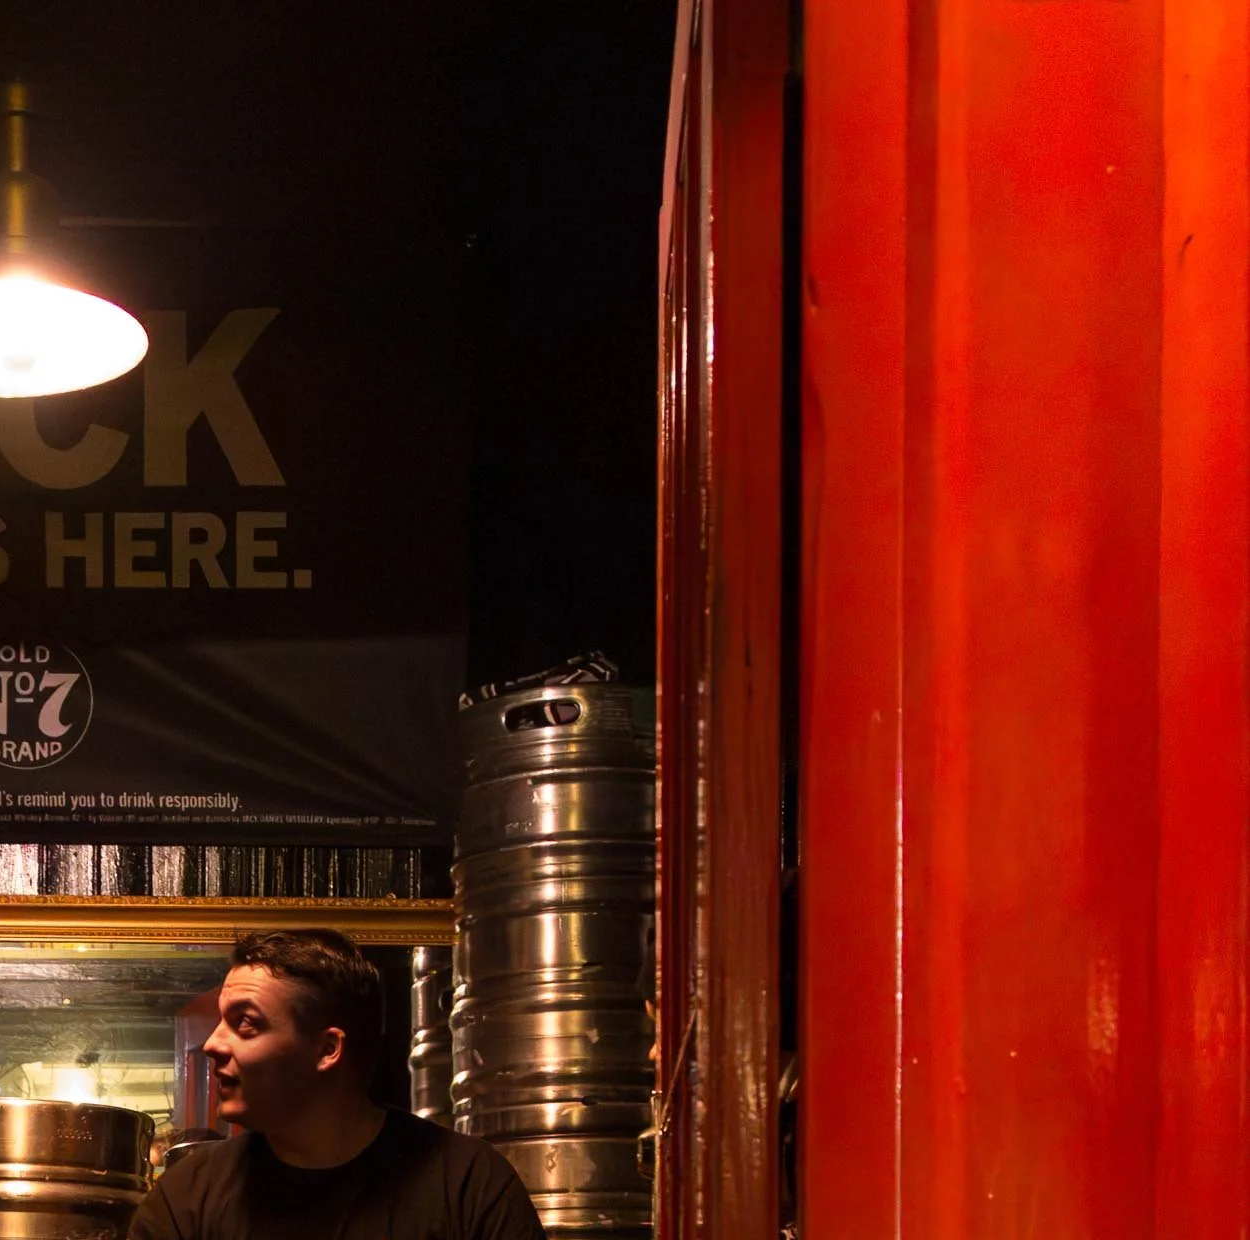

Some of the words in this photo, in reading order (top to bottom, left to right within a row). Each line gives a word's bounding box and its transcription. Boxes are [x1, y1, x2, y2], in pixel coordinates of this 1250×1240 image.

[45, 510, 314, 590] HERE.
[17, 792, 66, 808] remind
[70, 795, 96, 812] you
[100, 794, 115, 808] to
[119, 792, 155, 808] drink
[158, 792, 243, 812] responsibly.
